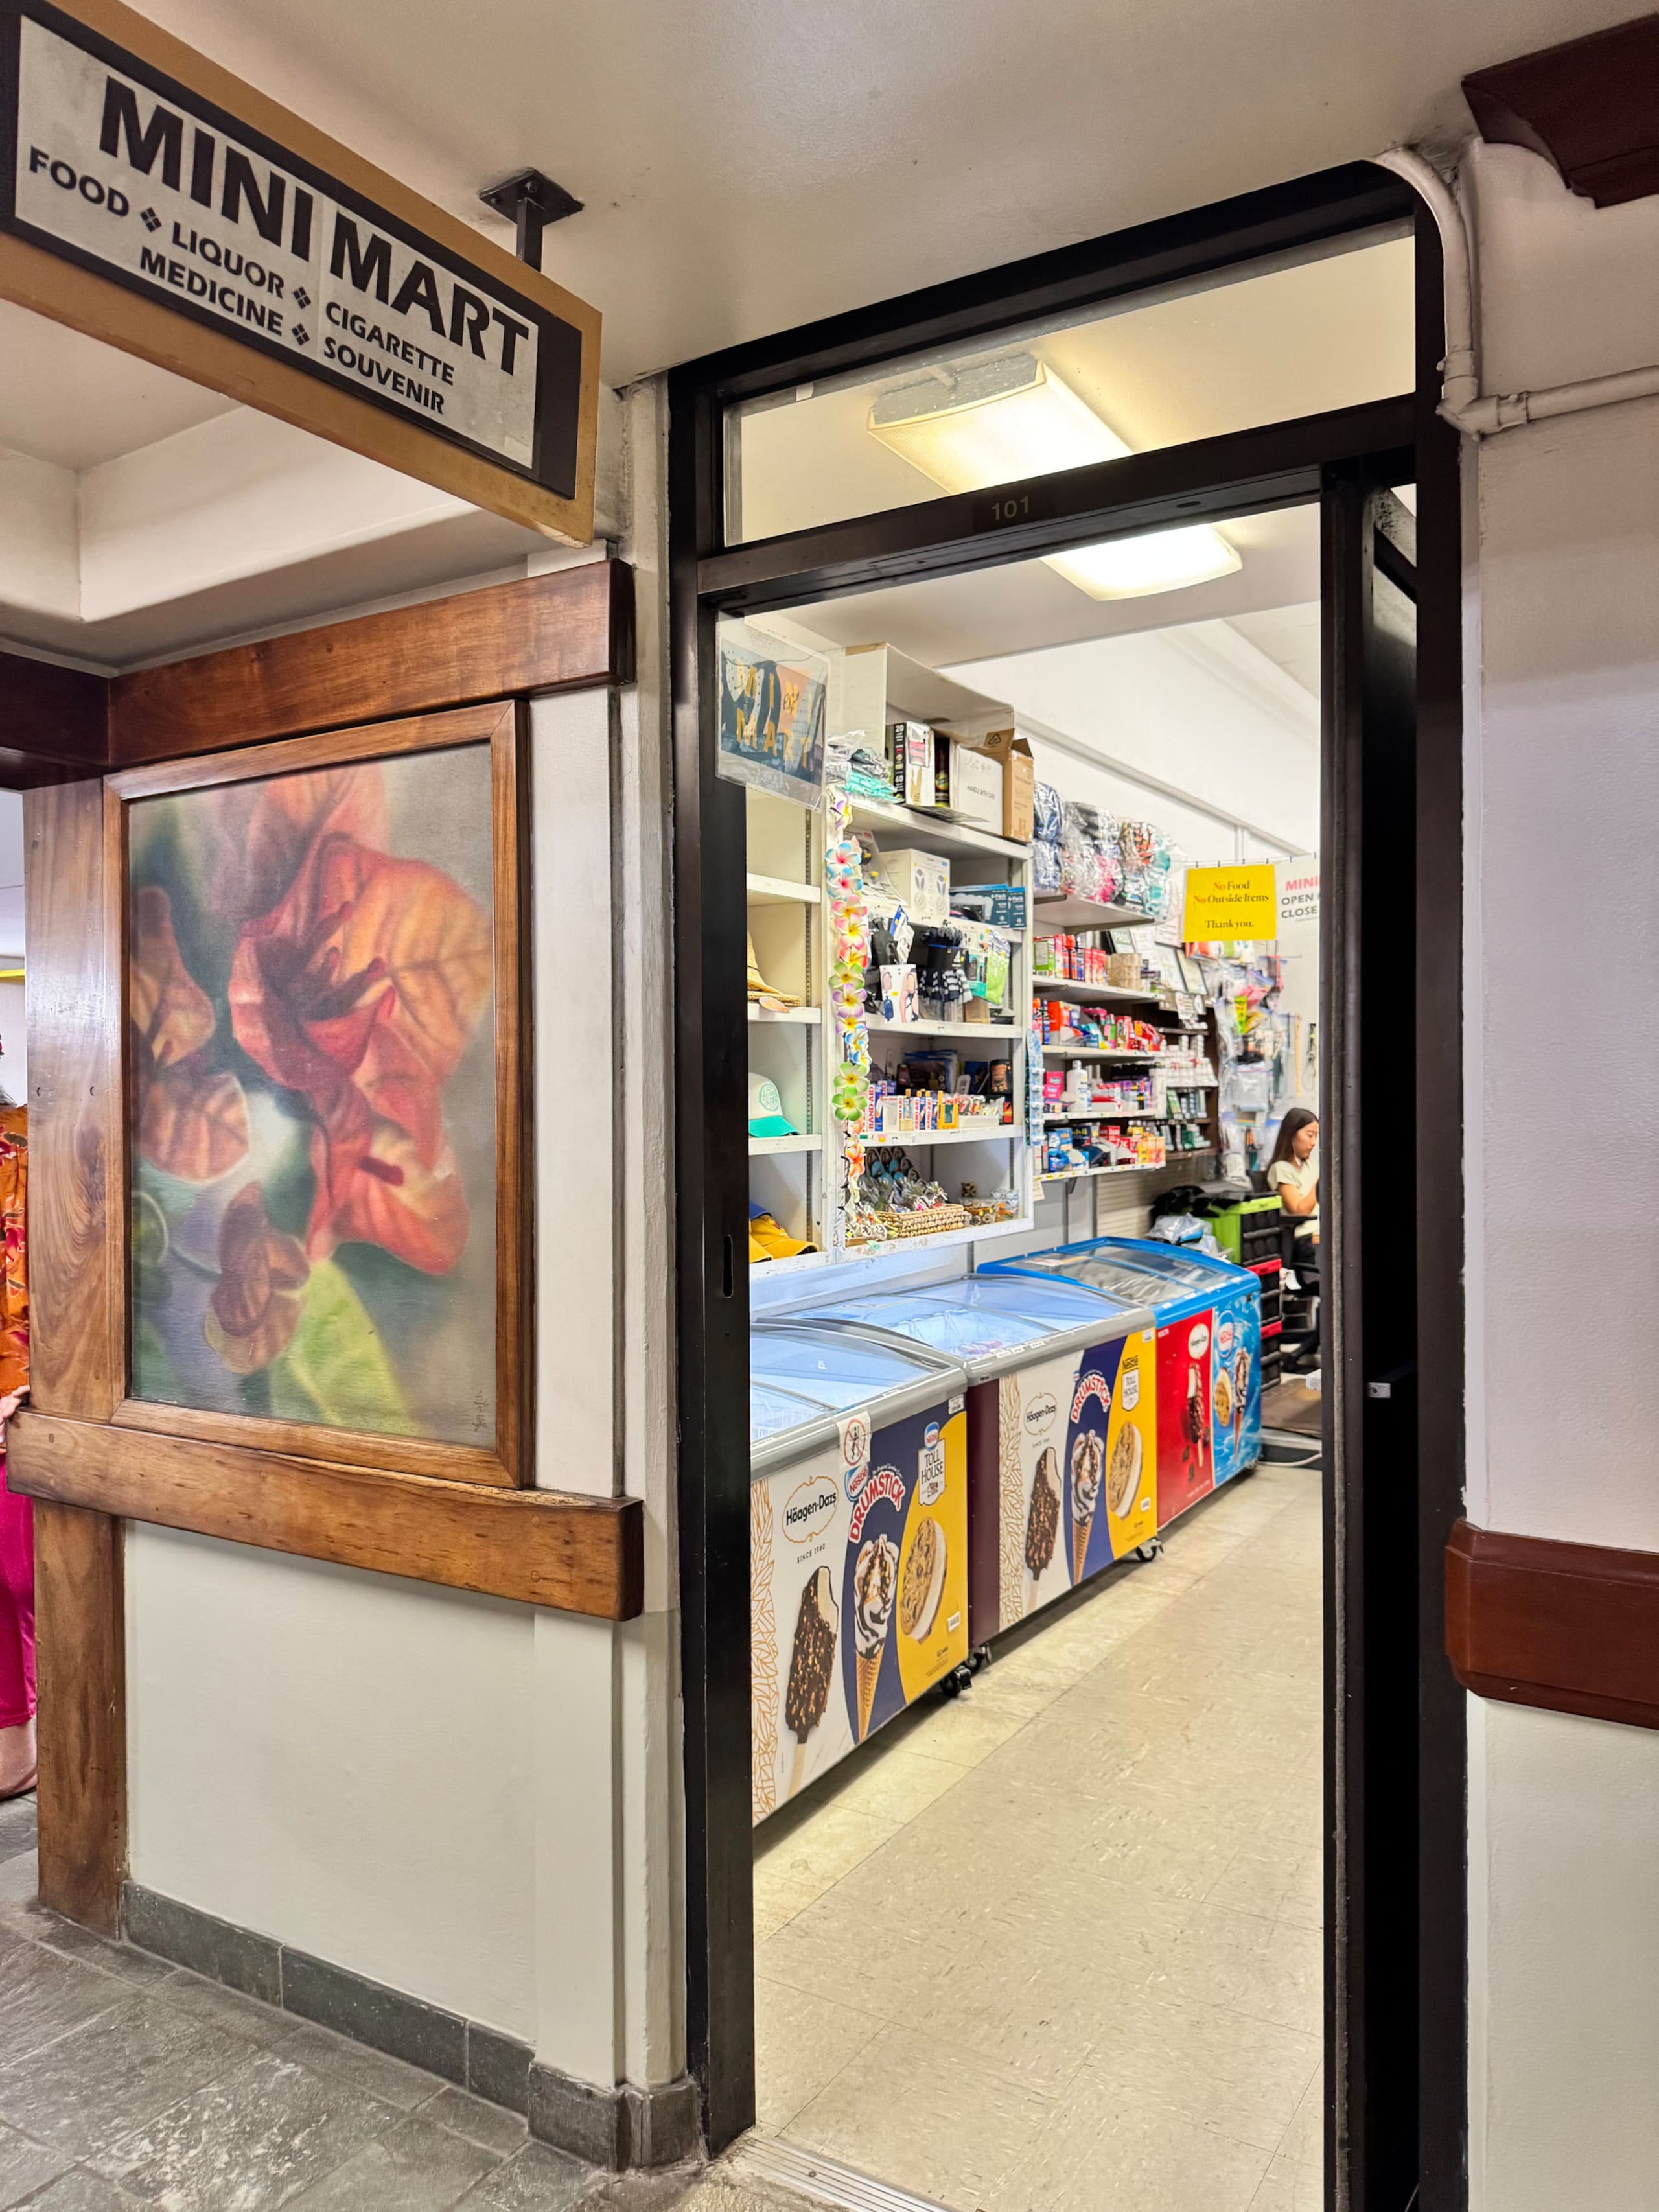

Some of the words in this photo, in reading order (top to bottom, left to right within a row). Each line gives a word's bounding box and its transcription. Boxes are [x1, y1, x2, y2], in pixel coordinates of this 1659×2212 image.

[99, 75, 314, 262] MINI
[329, 211, 529, 376] MART
[29, 145, 130, 218] FOOD
[172, 221, 284, 299] LIQUOR
[325, 301, 455, 386] CIGARETTE
[139, 246, 283, 337] MEDICINE
[324, 336, 445, 415] SOUVENIR
[992, 495, 1029, 520] 101
[736, 658, 813, 724] MINI
[736, 707, 811, 769] MART
[1213, 881, 1226, 891] No
[1227, 880, 1250, 891] Food
[1285, 876, 1319, 892] MINI
[1193, 895, 1206, 905] No
[1207, 894, 1242, 903] Outside
[1244, 892, 1270, 902] Items
[1281, 893, 1314, 905] OPEN
[1281, 905, 1317, 918] CLOSE
[1205, 919, 1234, 929] Thank
[1071, 1374, 1111, 1423] DRUMSTICK
[924, 1449, 940, 1468] TOLL
[921, 1461, 944, 1484] HOUSE
[786, 1493, 837, 1526] Häagen-Dazs
[849, 1471, 905, 1543] DRUMSTICK
[796, 1550, 812, 1564] SINCE
